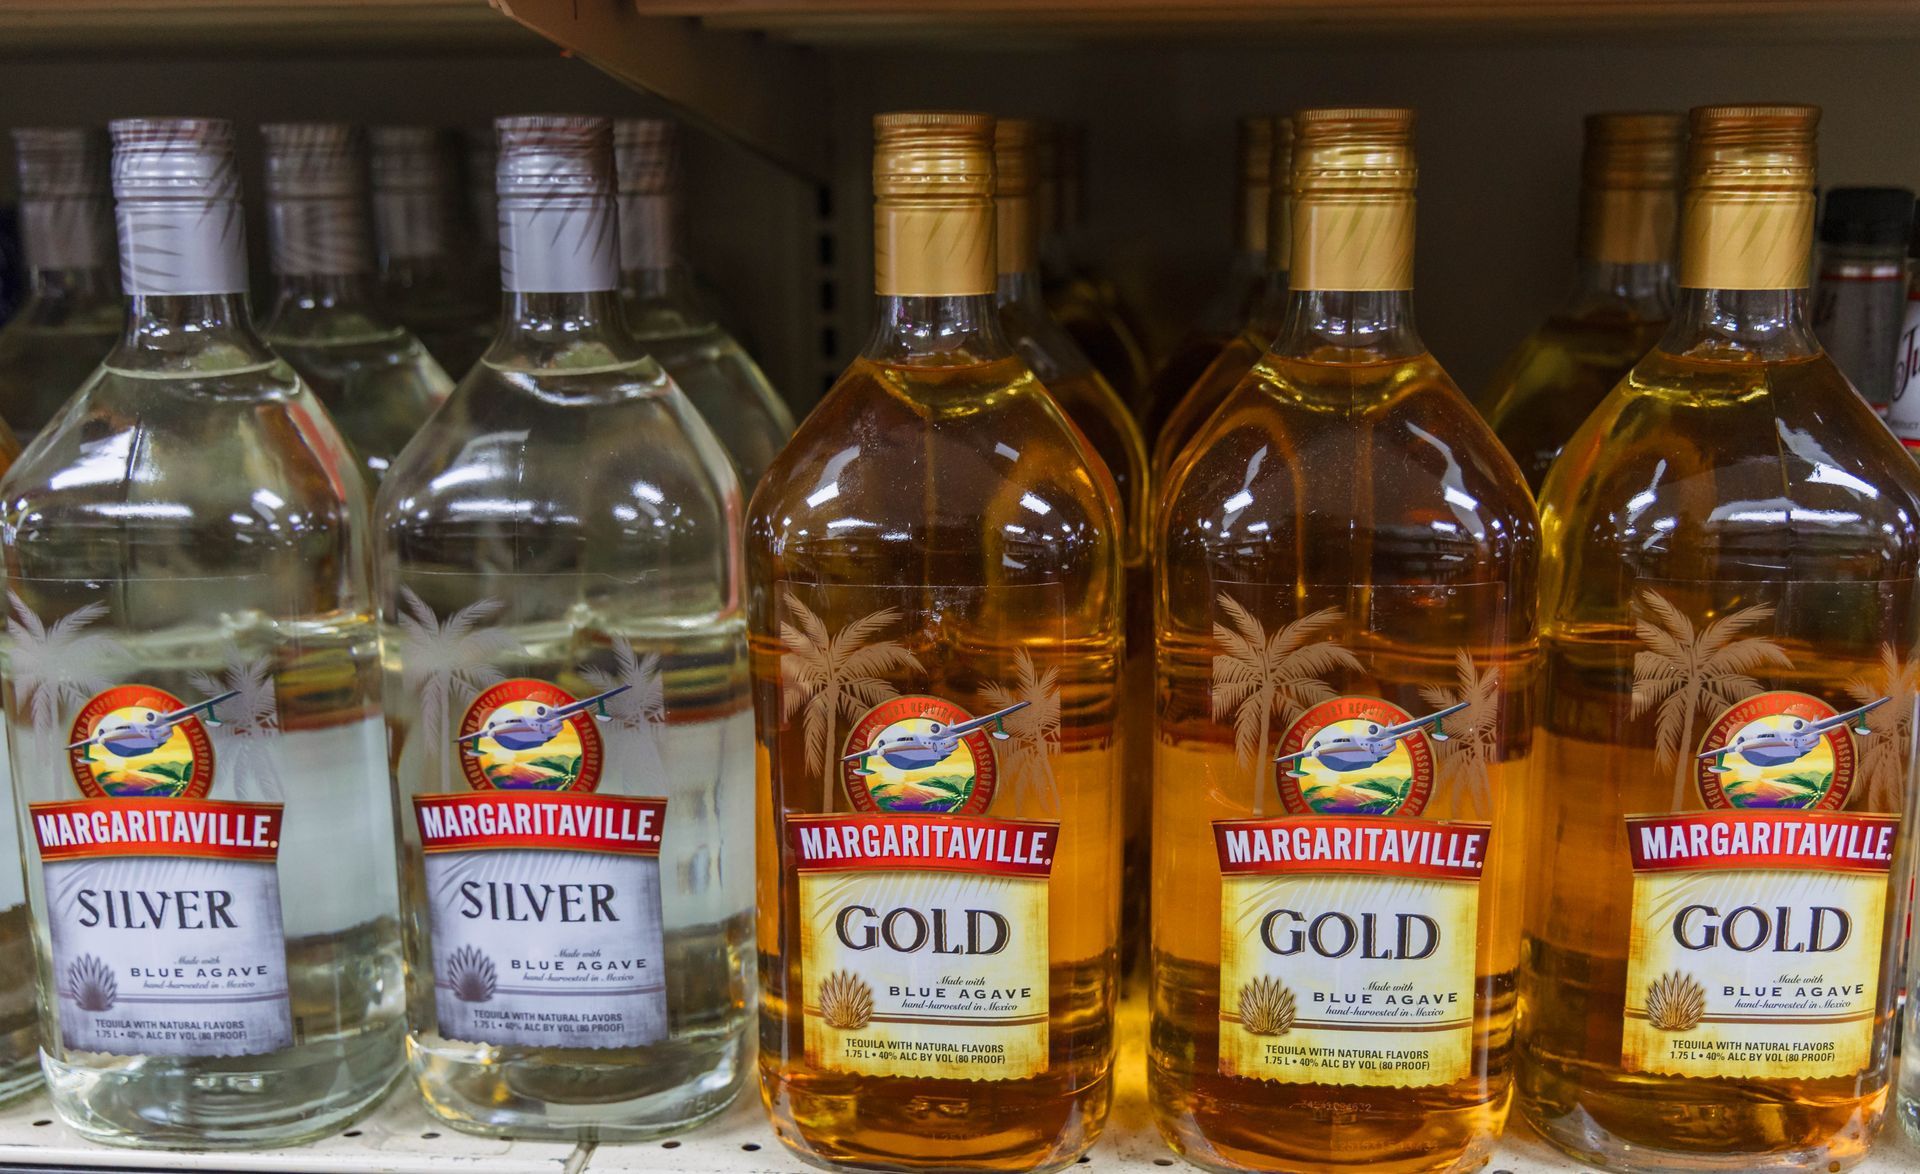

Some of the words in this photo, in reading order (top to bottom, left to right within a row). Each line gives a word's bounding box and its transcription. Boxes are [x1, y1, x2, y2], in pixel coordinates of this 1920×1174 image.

[1411, 741, 1428, 794] PASSPORT
[1833, 736, 1850, 788] PASSPORT
[460, 880, 620, 923] SILVER
[77, 889, 240, 930] SILVER
[835, 905, 1011, 956] GOLD
[1260, 908, 1441, 961] GOLD
[1672, 904, 1853, 953] GOLD
[511, 960, 564, 970] BLUE
[577, 959, 646, 970] AGAVE
[131, 968, 184, 977] BLUE
[196, 966, 268, 977] AGAVE
[937, 976, 964, 985] Made
[966, 977, 985, 986] with
[1773, 974, 1801, 983] Made
[1803, 975, 1823, 983] with
[1363, 981, 1391, 991] Made
[1393, 982, 1413, 991] with
[1724, 986, 1782, 996] BLUE
[1795, 984, 1864, 997] AGAVE
[889, 986, 946, 998] BLUE
[959, 988, 1031, 999] AGAVE
[1314, 992, 1372, 1004] BLUE
[1385, 993, 1458, 1005] AGAVE
[901, 999, 973, 1011] hand-harvested
[973, 1002, 982, 1011] in
[984, 1001, 1018, 1011] Mexico
[1735, 998, 1808, 1009] hand-harvested
[1809, 1000, 1817, 1008] in
[1819, 999, 1851, 1009] Mexico
[474, 1010, 510, 1020] TEQUILA
[512, 1012, 535, 1021] WITH
[538, 1013, 580, 1022] NATURAL
[582, 1014, 622, 1022] FLAVORS
[1326, 1005, 1399, 1016] hand-harvested
[1400, 1008, 1408, 1016] in
[1411, 1007, 1444, 1017] Mexico
[96, 1019, 131, 1028] TEQUILA
[134, 1021, 157, 1029] WITH
[160, 1021, 201, 1030] NATURAL
[204, 1021, 244, 1029] FLAVORS
[524, 1023, 541, 1031] ALC
[543, 1024, 554, 1032] BY
[557, 1024, 574, 1032] VOL
[592, 1023, 625, 1033] PROOF)
[146, 1031, 163, 1039] ALC
[166, 1032, 177, 1040] BY
[180, 1032, 197, 1040] VOL
[214, 1031, 247, 1040] PROOF)
[846, 1038, 885, 1049] TEQUILA
[888, 1041, 913, 1050] WITH
[915, 1042, 959, 1052] NATURAL
[962, 1044, 1004, 1053] FLAVORS
[1673, 1040, 1713, 1050] TEQUILA
[1716, 1041, 1742, 1050] WITH
[1745, 1042, 1790, 1051] NATURAL
[1792, 1042, 1835, 1051] FLAVORS
[845, 1050, 862, 1058] 1.75
[879, 1052, 897, 1060] 40%
[900, 1052, 918, 1061] ALC
[920, 1053, 933, 1061] BY
[936, 1054, 953, 1062] VOL
[955, 1055, 969, 1064] (80
[971, 1055, 1005, 1064] PROOF)
[1266, 1045, 1306, 1056] TEQUILA
[1309, 1047, 1335, 1057] WITH
[1338, 1049, 1384, 1059] NATURAL
[1386, 1050, 1429, 1059] FLAVORS
[1670, 1052, 1689, 1060] 1.75
[1706, 1052, 1725, 1061] 40%
[1728, 1052, 1746, 1061] ALC
[1749, 1053, 1762, 1062] BY
[1765, 1053, 1783, 1062] VOL
[1786, 1053, 1799, 1063] (80
[1801, 1053, 1835, 1063] PROOF)
[1265, 1056, 1282, 1065] 1.75
[1300, 1058, 1319, 1067] 40%
[1321, 1059, 1340, 1068] ALC
[1342, 1059, 1356, 1069] BY
[1358, 1060, 1377, 1070] VOL
[1379, 1061, 1393, 1071] (80
[1396, 1061, 1430, 1071] PROOF)
